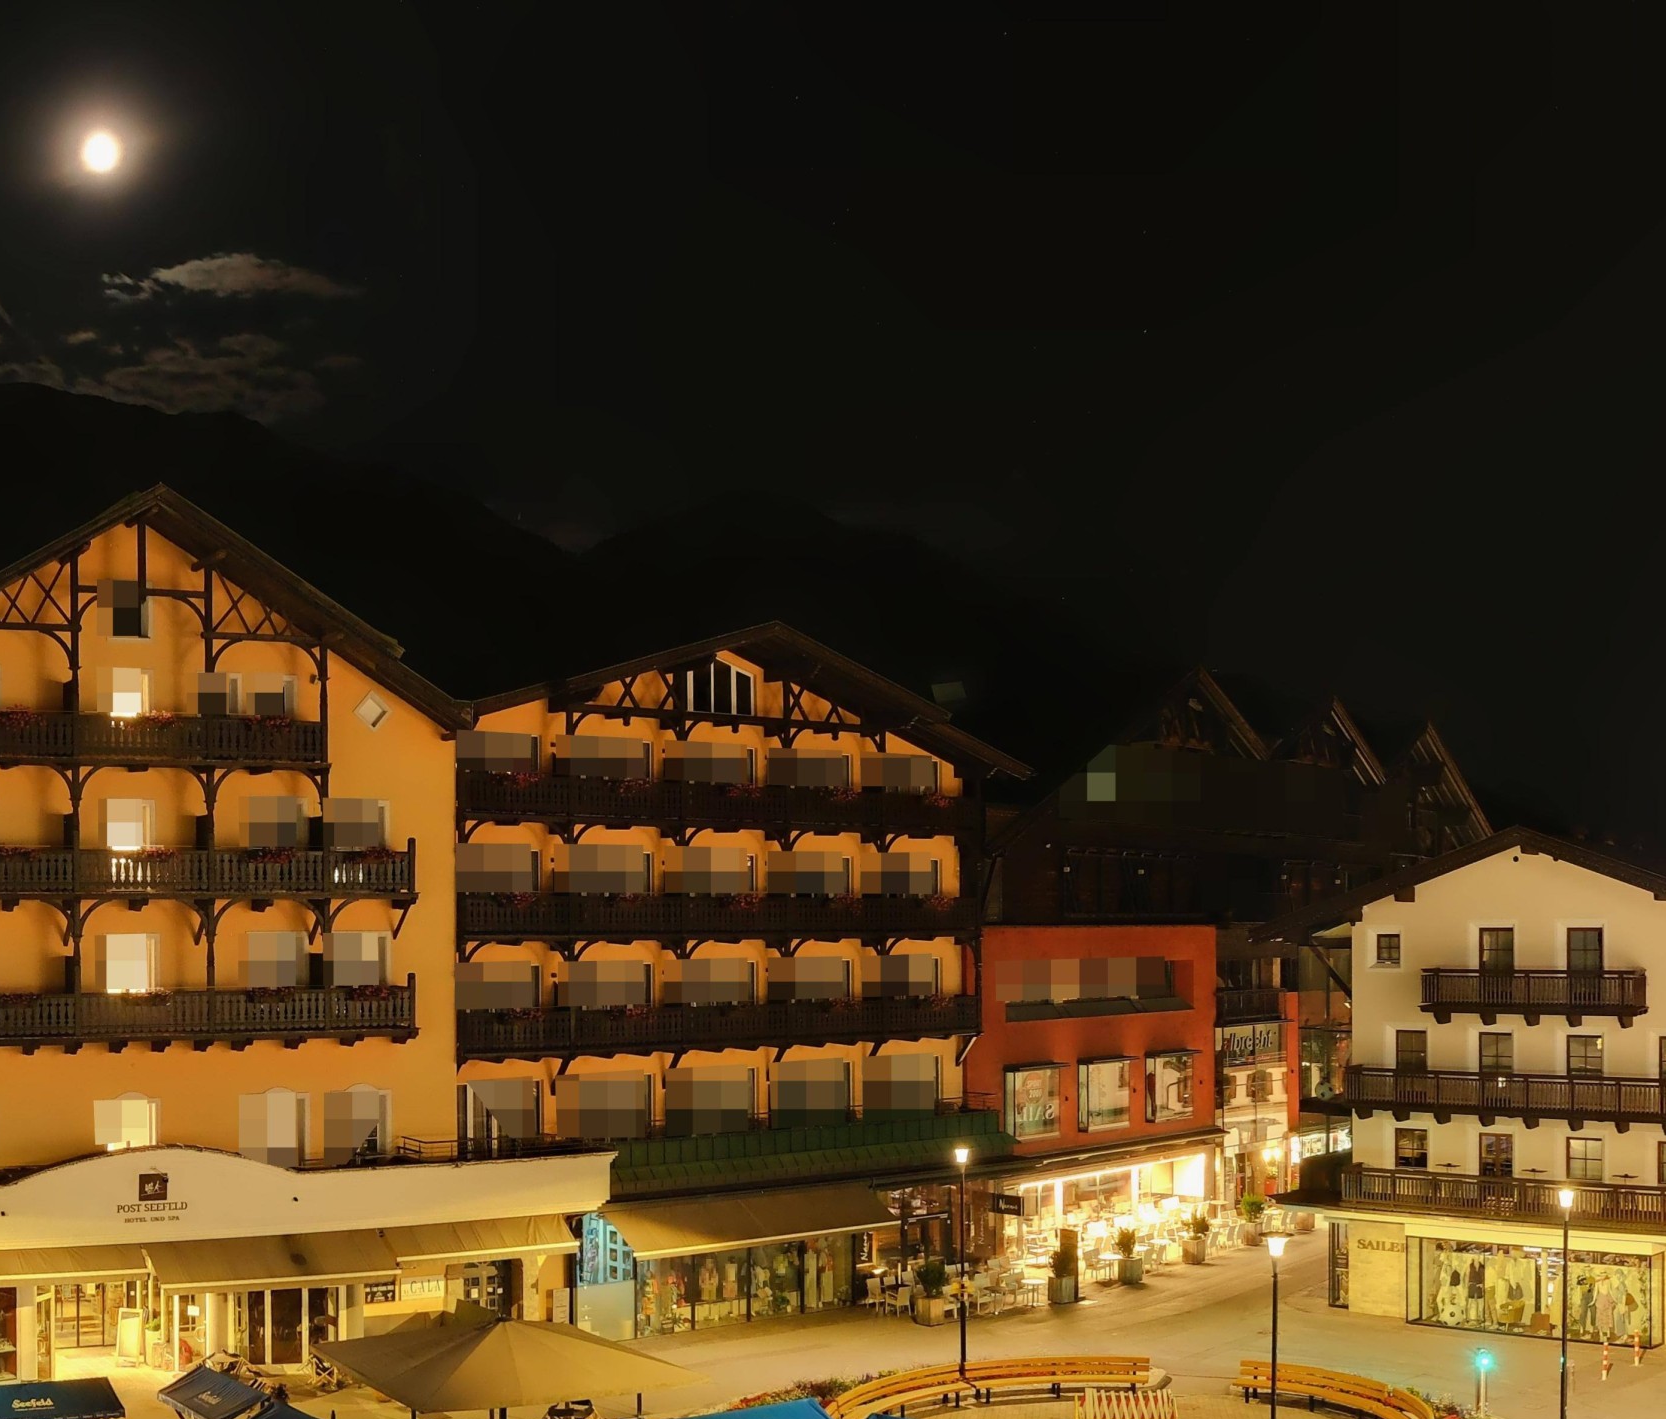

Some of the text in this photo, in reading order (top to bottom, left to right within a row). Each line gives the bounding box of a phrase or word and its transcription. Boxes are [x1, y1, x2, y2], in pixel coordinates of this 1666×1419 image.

[117, 1201, 188, 1213] POST SEEFELD
[12, 1398, 53, 1408] Seefeld
